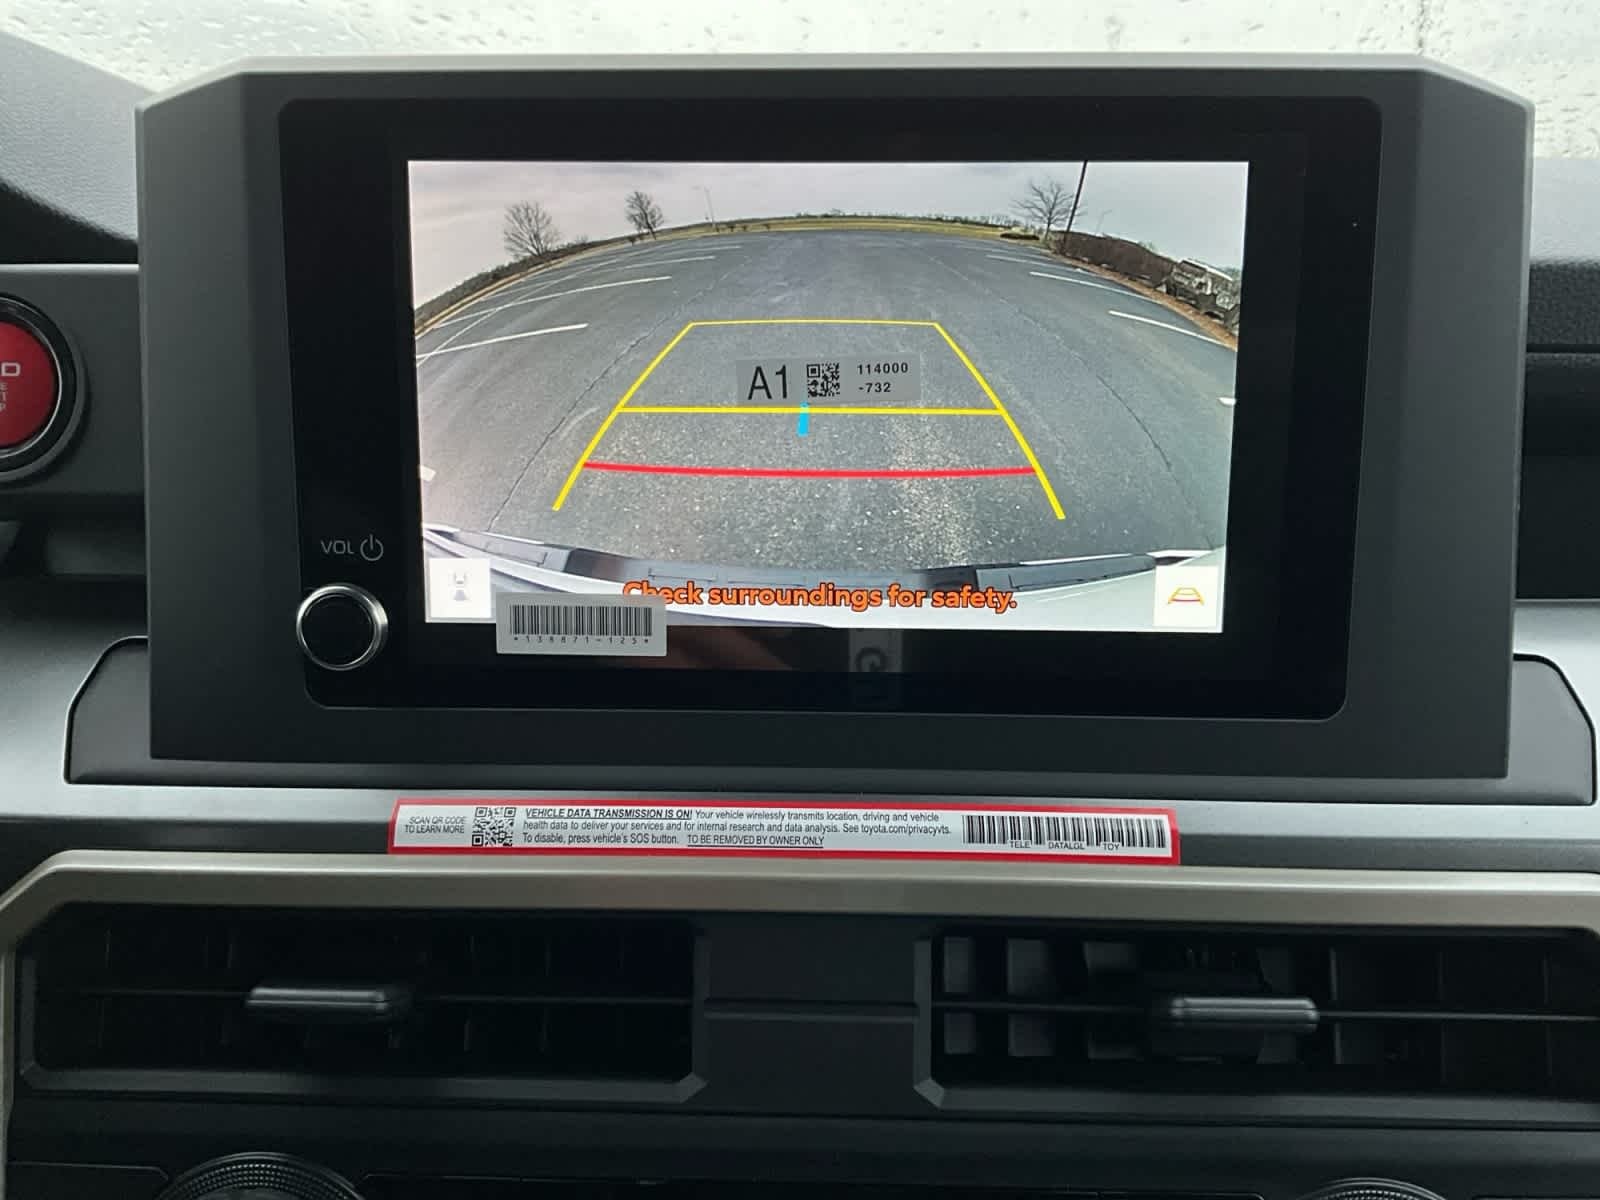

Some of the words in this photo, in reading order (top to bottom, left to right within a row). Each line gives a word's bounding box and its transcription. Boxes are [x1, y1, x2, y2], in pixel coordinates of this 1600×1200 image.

[857, 362, 909, 375] 114000
[747, 365, 788, 400] A1
[858, 382, 892, 393] -732
[320, 540, 355, 554] VOL
[623, 580, 704, 605] Check
[708, 582, 883, 612] surroundings
[888, 583, 928, 608] for
[931, 584, 1018, 614] safety.
[409, 816, 430, 825] SCAN
[431, 816, 444, 825] QR
[445, 816, 466, 825] CODE
[526, 808, 566, 818] VEHICLE
[567, 808, 592, 818] DATA
[593, 809, 663, 819] TRANSMISSION
[664, 809, 674, 819] IS
[676, 809, 693, 820] ON!
[695, 810, 716, 820] Your
[716, 810, 744, 820] vehicle
[746, 811, 785, 822] wirelessly
[787, 811, 824, 821] transmits
[826, 812, 861, 823] location,
[862, 812, 890, 823] driving
[892, 812, 908, 822] and
[910, 813, 939, 822] vehicle
[405, 825, 415, 833] TO
[416, 825, 442, 834] LEARN
[443, 825, 465, 834] MORE
[523, 820, 549, 830] health
[550, 821, 568, 830] data
[570, 821, 579, 830] to
[581, 821, 609, 830] deliver
[610, 823, 629, 833] your
[630, 822, 664, 831] services
[666, 822, 682, 831] and
[683, 822, 695, 831] for
[697, 822, 728, 832] internal
[729, 823, 765, 832] research
[767, 823, 782, 832] and
[784, 823, 802, 833] data
[804, 823, 840, 834] analysis.
[842, 823, 859, 833] See
[861, 824, 952, 836] toyota.com/privacyvts.
[522, 832, 533, 843] To
[534, 833, 566, 844] disable,
[568, 834, 591, 845] press
[592, 833, 628, 843] vehicle's
[630, 833, 650, 843] SOS
[651, 834, 679, 844] button.
[687, 834, 699, 844] TO
[700, 835, 712, 844] BE
[713, 835, 755, 845] REMOVED
[757, 836, 768, 845] BY
[768, 835, 801, 846] OWNER
[802, 836, 825, 846] ONLY
[1009, 840, 1031, 849] TELE
[1102, 843, 1120, 851] TOY
